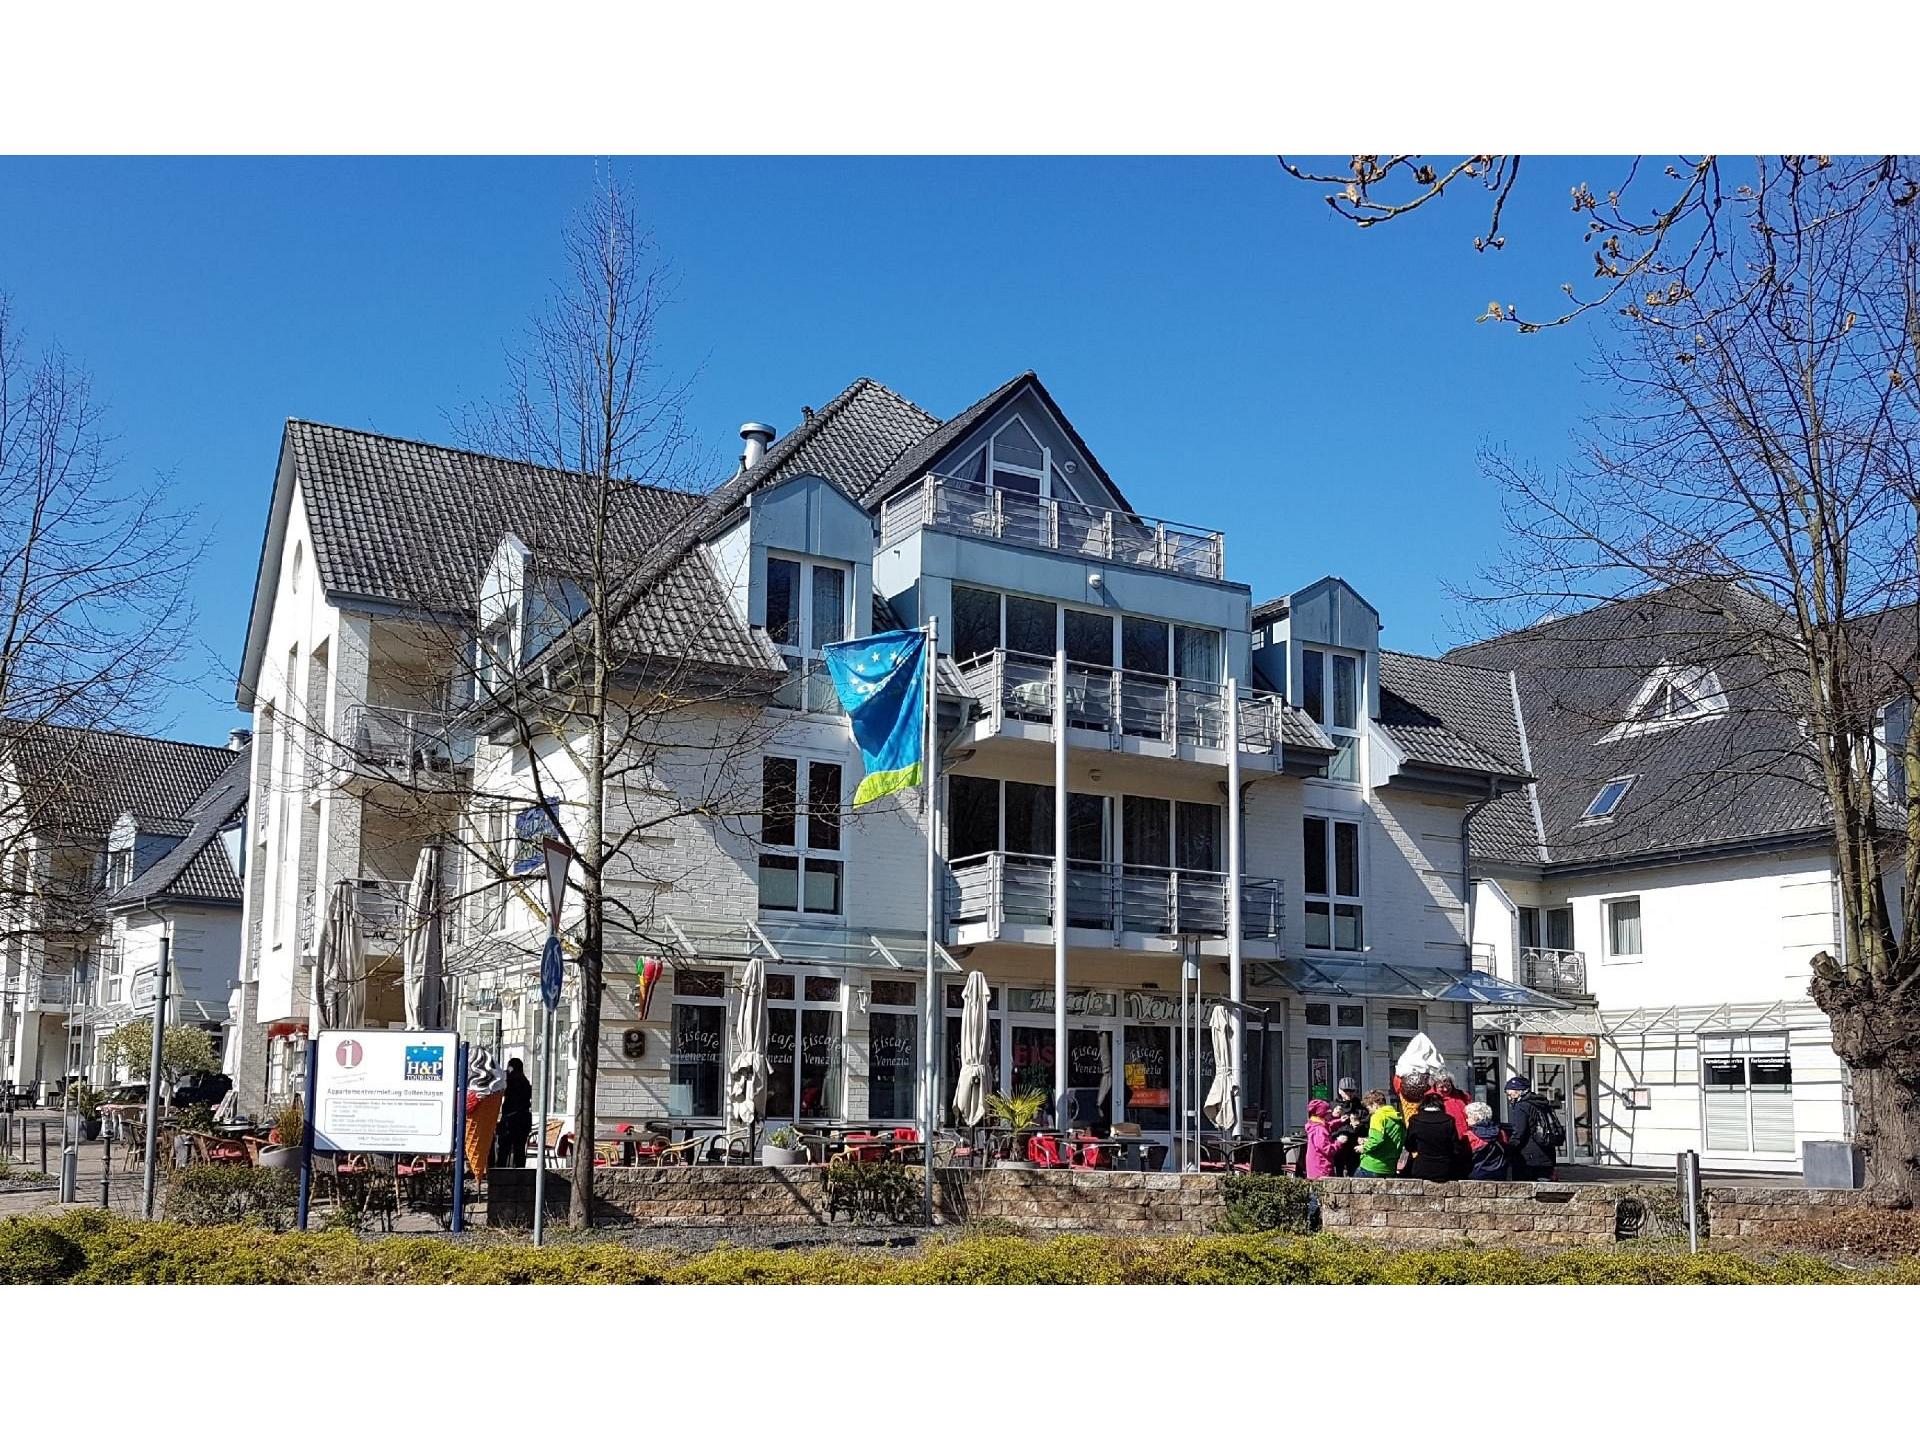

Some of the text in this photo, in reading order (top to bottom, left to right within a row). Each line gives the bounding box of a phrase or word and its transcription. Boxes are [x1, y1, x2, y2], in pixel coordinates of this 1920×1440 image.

[768, 1033, 795, 1051] cafe
[767, 1054, 793, 1064] nezia
[407, 1061, 442, 1075] H&P
